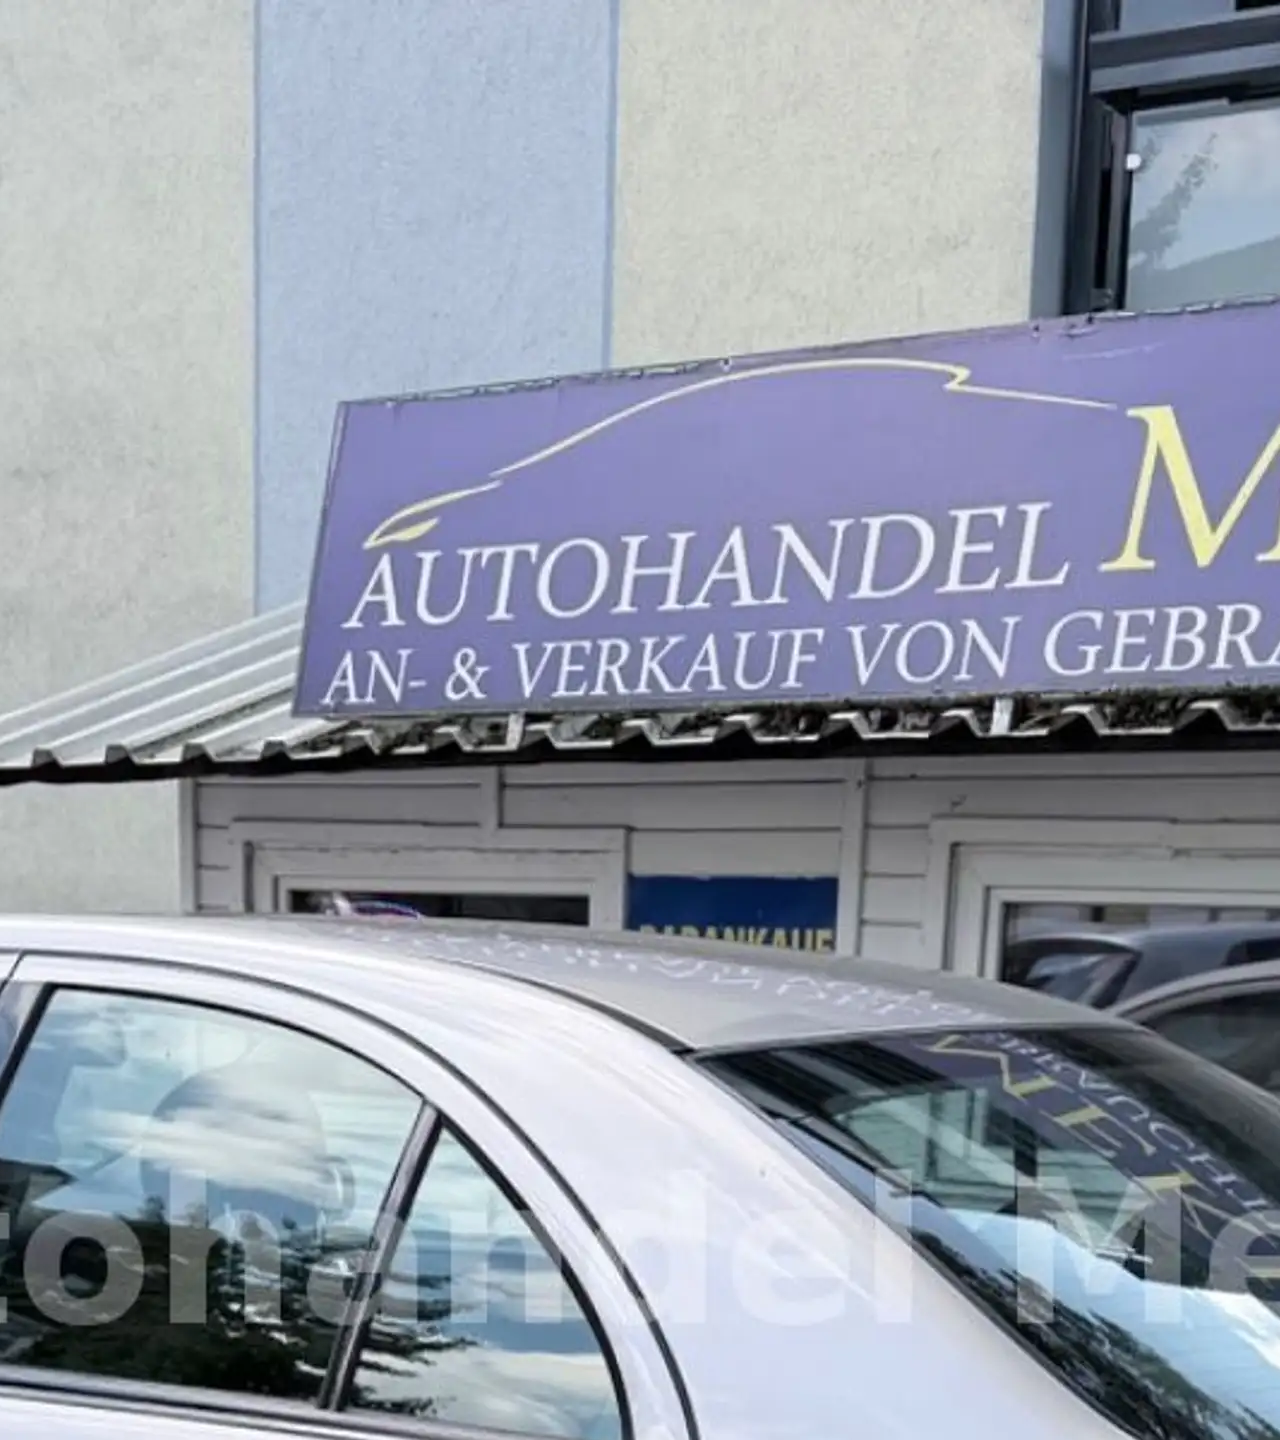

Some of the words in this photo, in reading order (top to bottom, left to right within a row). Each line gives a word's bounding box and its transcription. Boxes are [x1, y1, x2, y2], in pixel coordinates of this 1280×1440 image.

[341, 501, 1071, 629] AUTOHANDEL
[322, 648, 427, 706] AN-
[446, 647, 490, 702] &
[514, 627, 826, 700] VERKAUF
[845, 615, 1019, 687] VON
